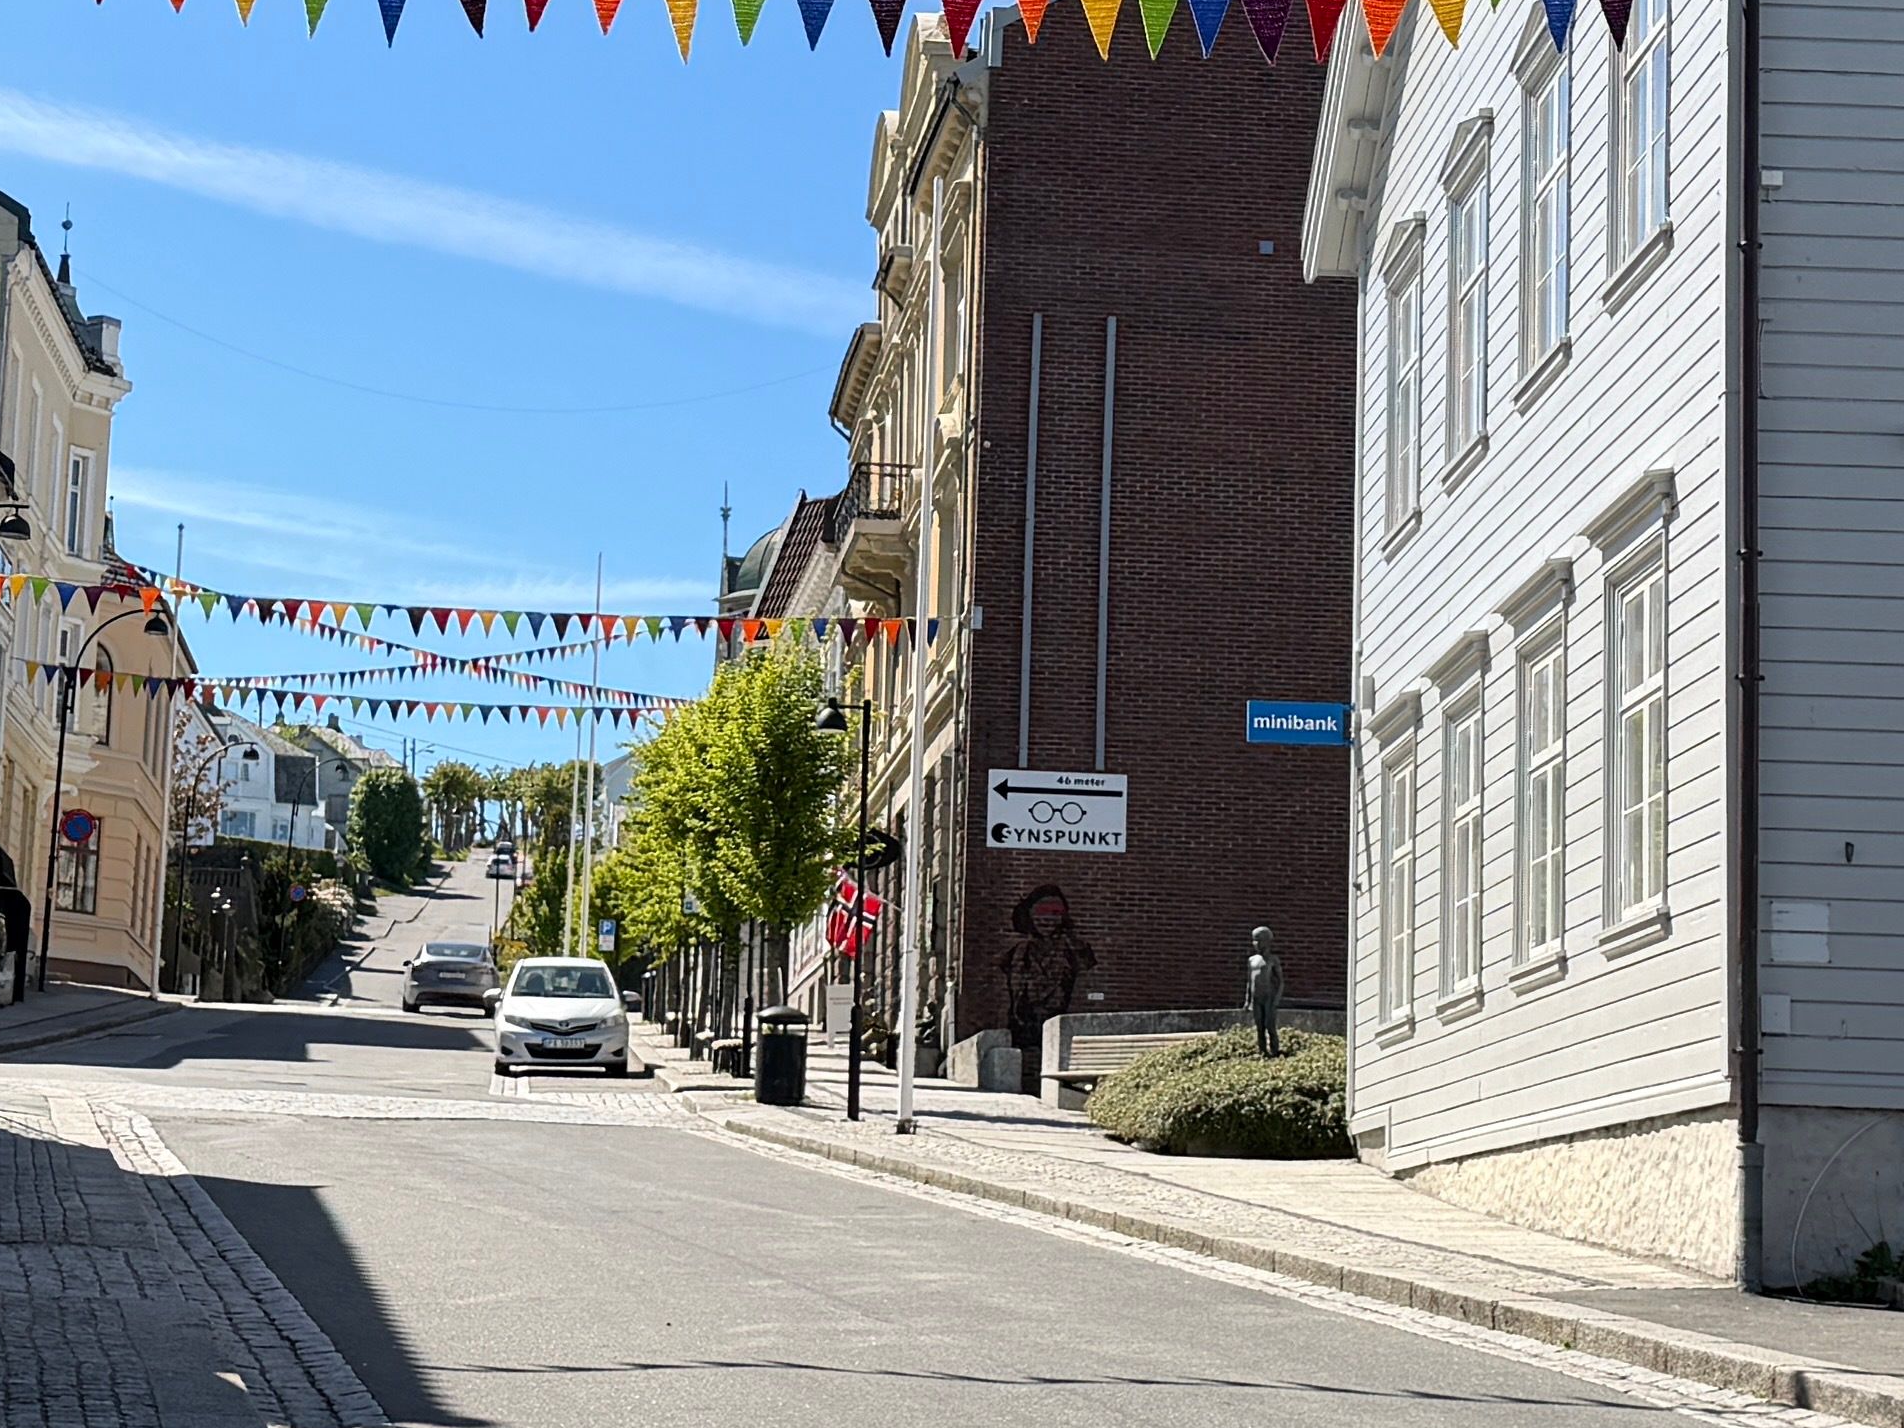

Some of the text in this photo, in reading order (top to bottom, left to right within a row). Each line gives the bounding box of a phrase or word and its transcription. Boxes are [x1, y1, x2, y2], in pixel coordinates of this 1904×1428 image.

[1253, 714, 1338, 731] minibank
[1056, 775, 1106, 787] 46 meter
[991, 822, 1123, 846] SYNSPUNKT
